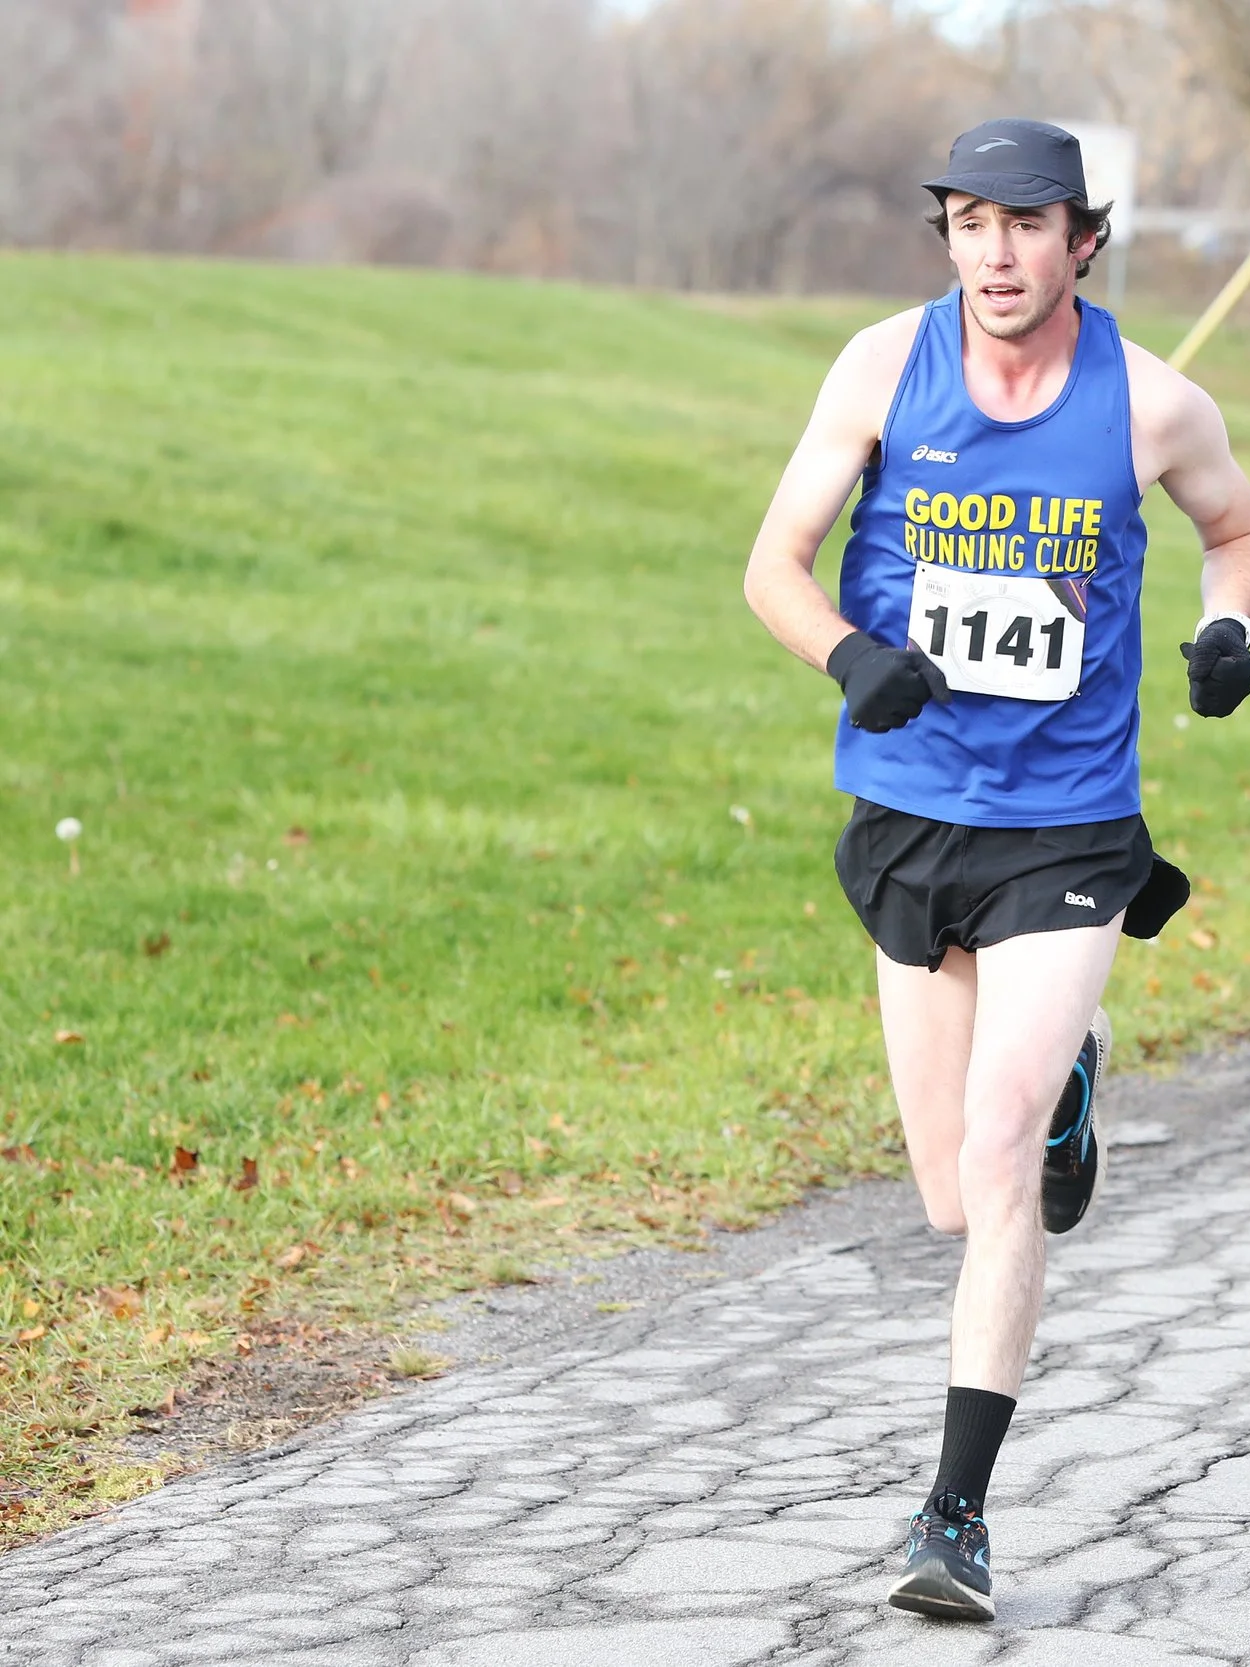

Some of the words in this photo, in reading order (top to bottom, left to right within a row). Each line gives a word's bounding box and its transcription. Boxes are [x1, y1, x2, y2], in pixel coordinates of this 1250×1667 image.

[925, 449, 958, 463] asics
[905, 487, 1016, 531] GOOD
[1028, 496, 1103, 536] LIFE
[904, 522, 1025, 570] RUNNING
[1035, 537, 1098, 573] CLUB
[925, 605, 1066, 669] 1141
[1064, 891, 1096, 909] BOA
